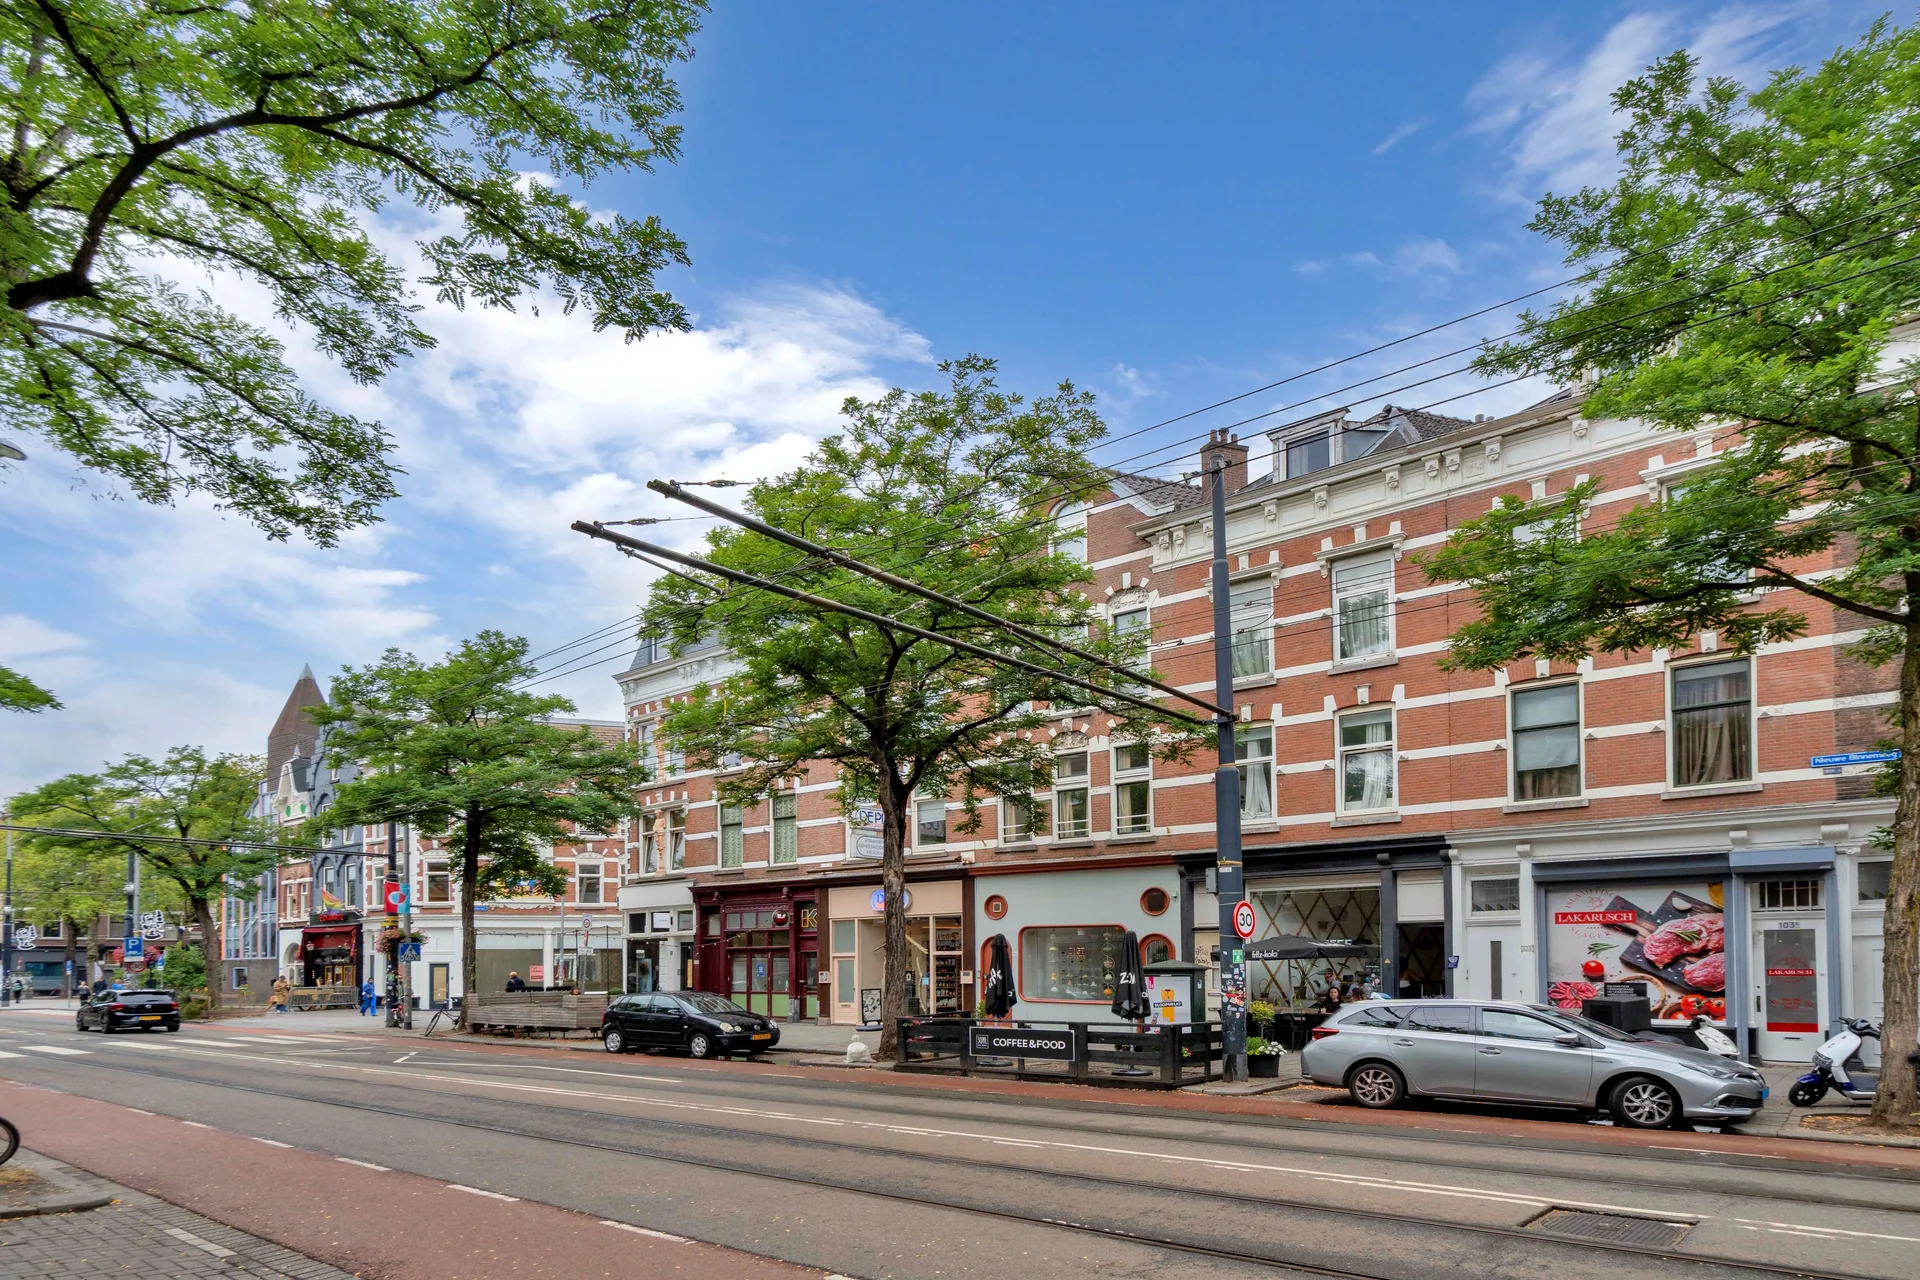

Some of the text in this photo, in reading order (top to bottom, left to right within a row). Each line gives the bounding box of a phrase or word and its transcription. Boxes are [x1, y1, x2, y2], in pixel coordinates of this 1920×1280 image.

[1815, 755, 1846, 763] Nieuwe
[1239, 913, 1252, 927] 30
[1557, 912, 1633, 922] LAKARUSCH
[128, 939, 139, 949] P
[993, 1038, 1066, 1049] COFFEE&FOOD
